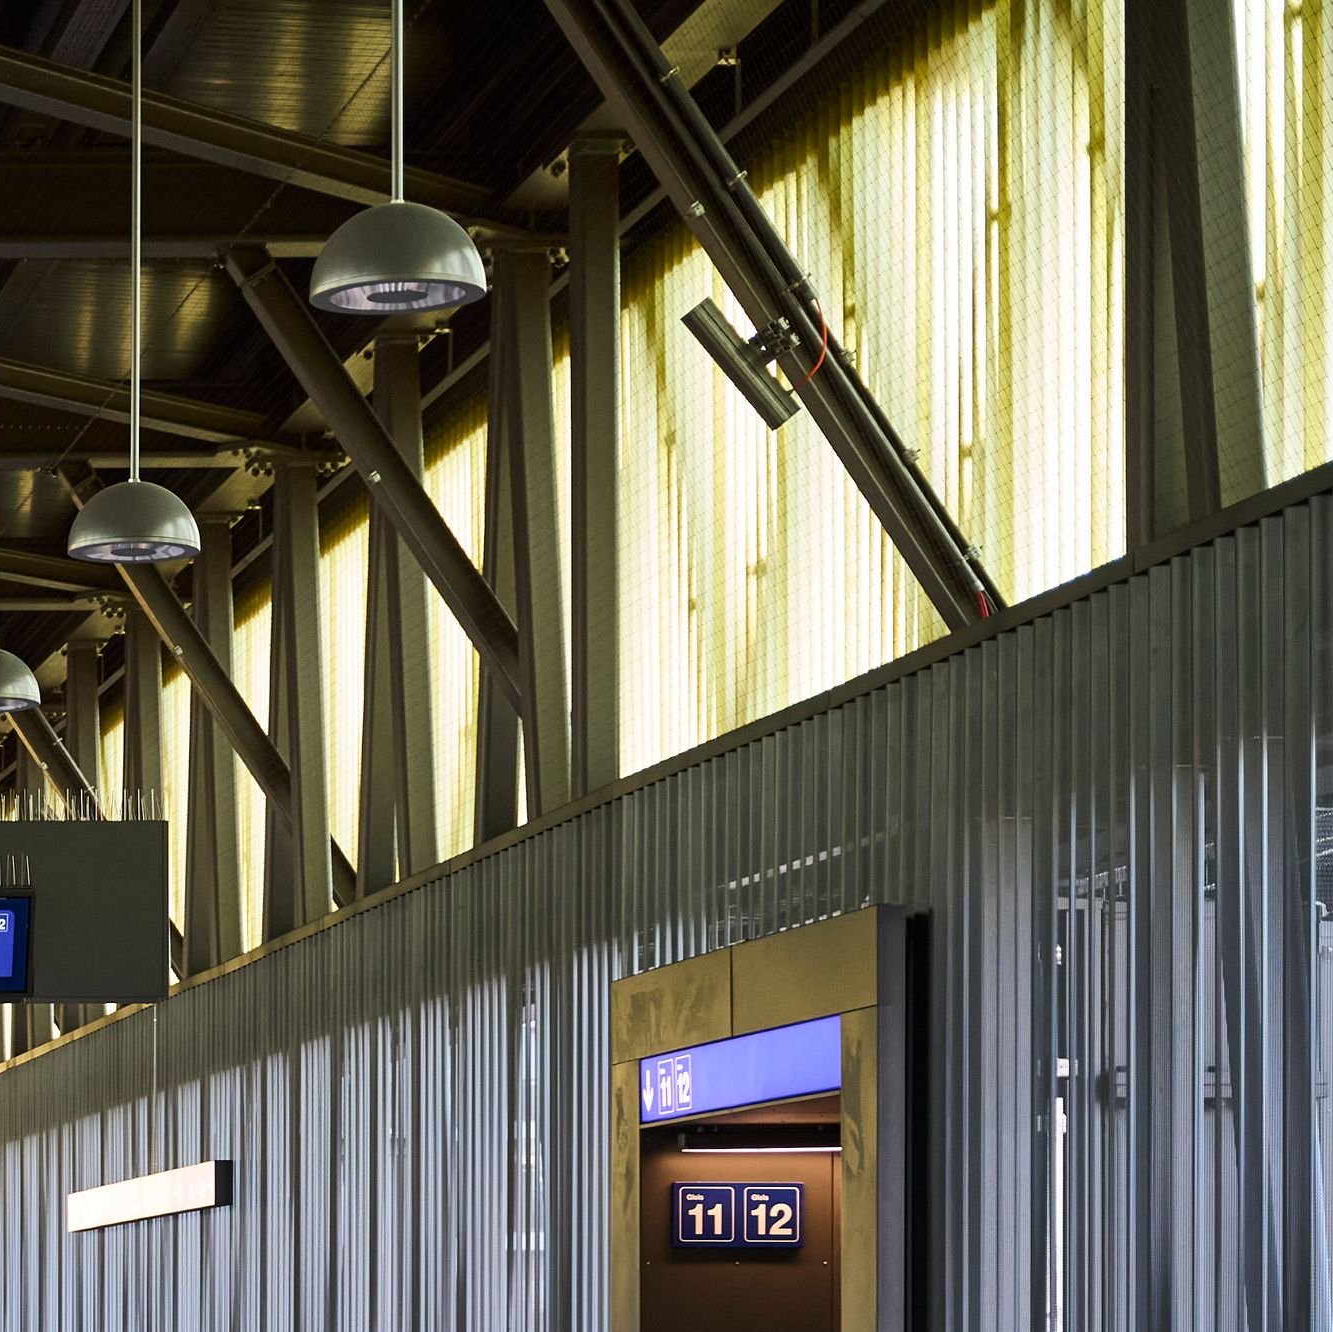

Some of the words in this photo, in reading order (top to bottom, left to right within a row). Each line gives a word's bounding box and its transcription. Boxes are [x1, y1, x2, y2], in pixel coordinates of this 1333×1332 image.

[660, 1075, 671, 1108] 11
[676, 1071, 691, 1104] 12
[688, 1203, 723, 1235] 11
[750, 1203, 793, 1235] 12
